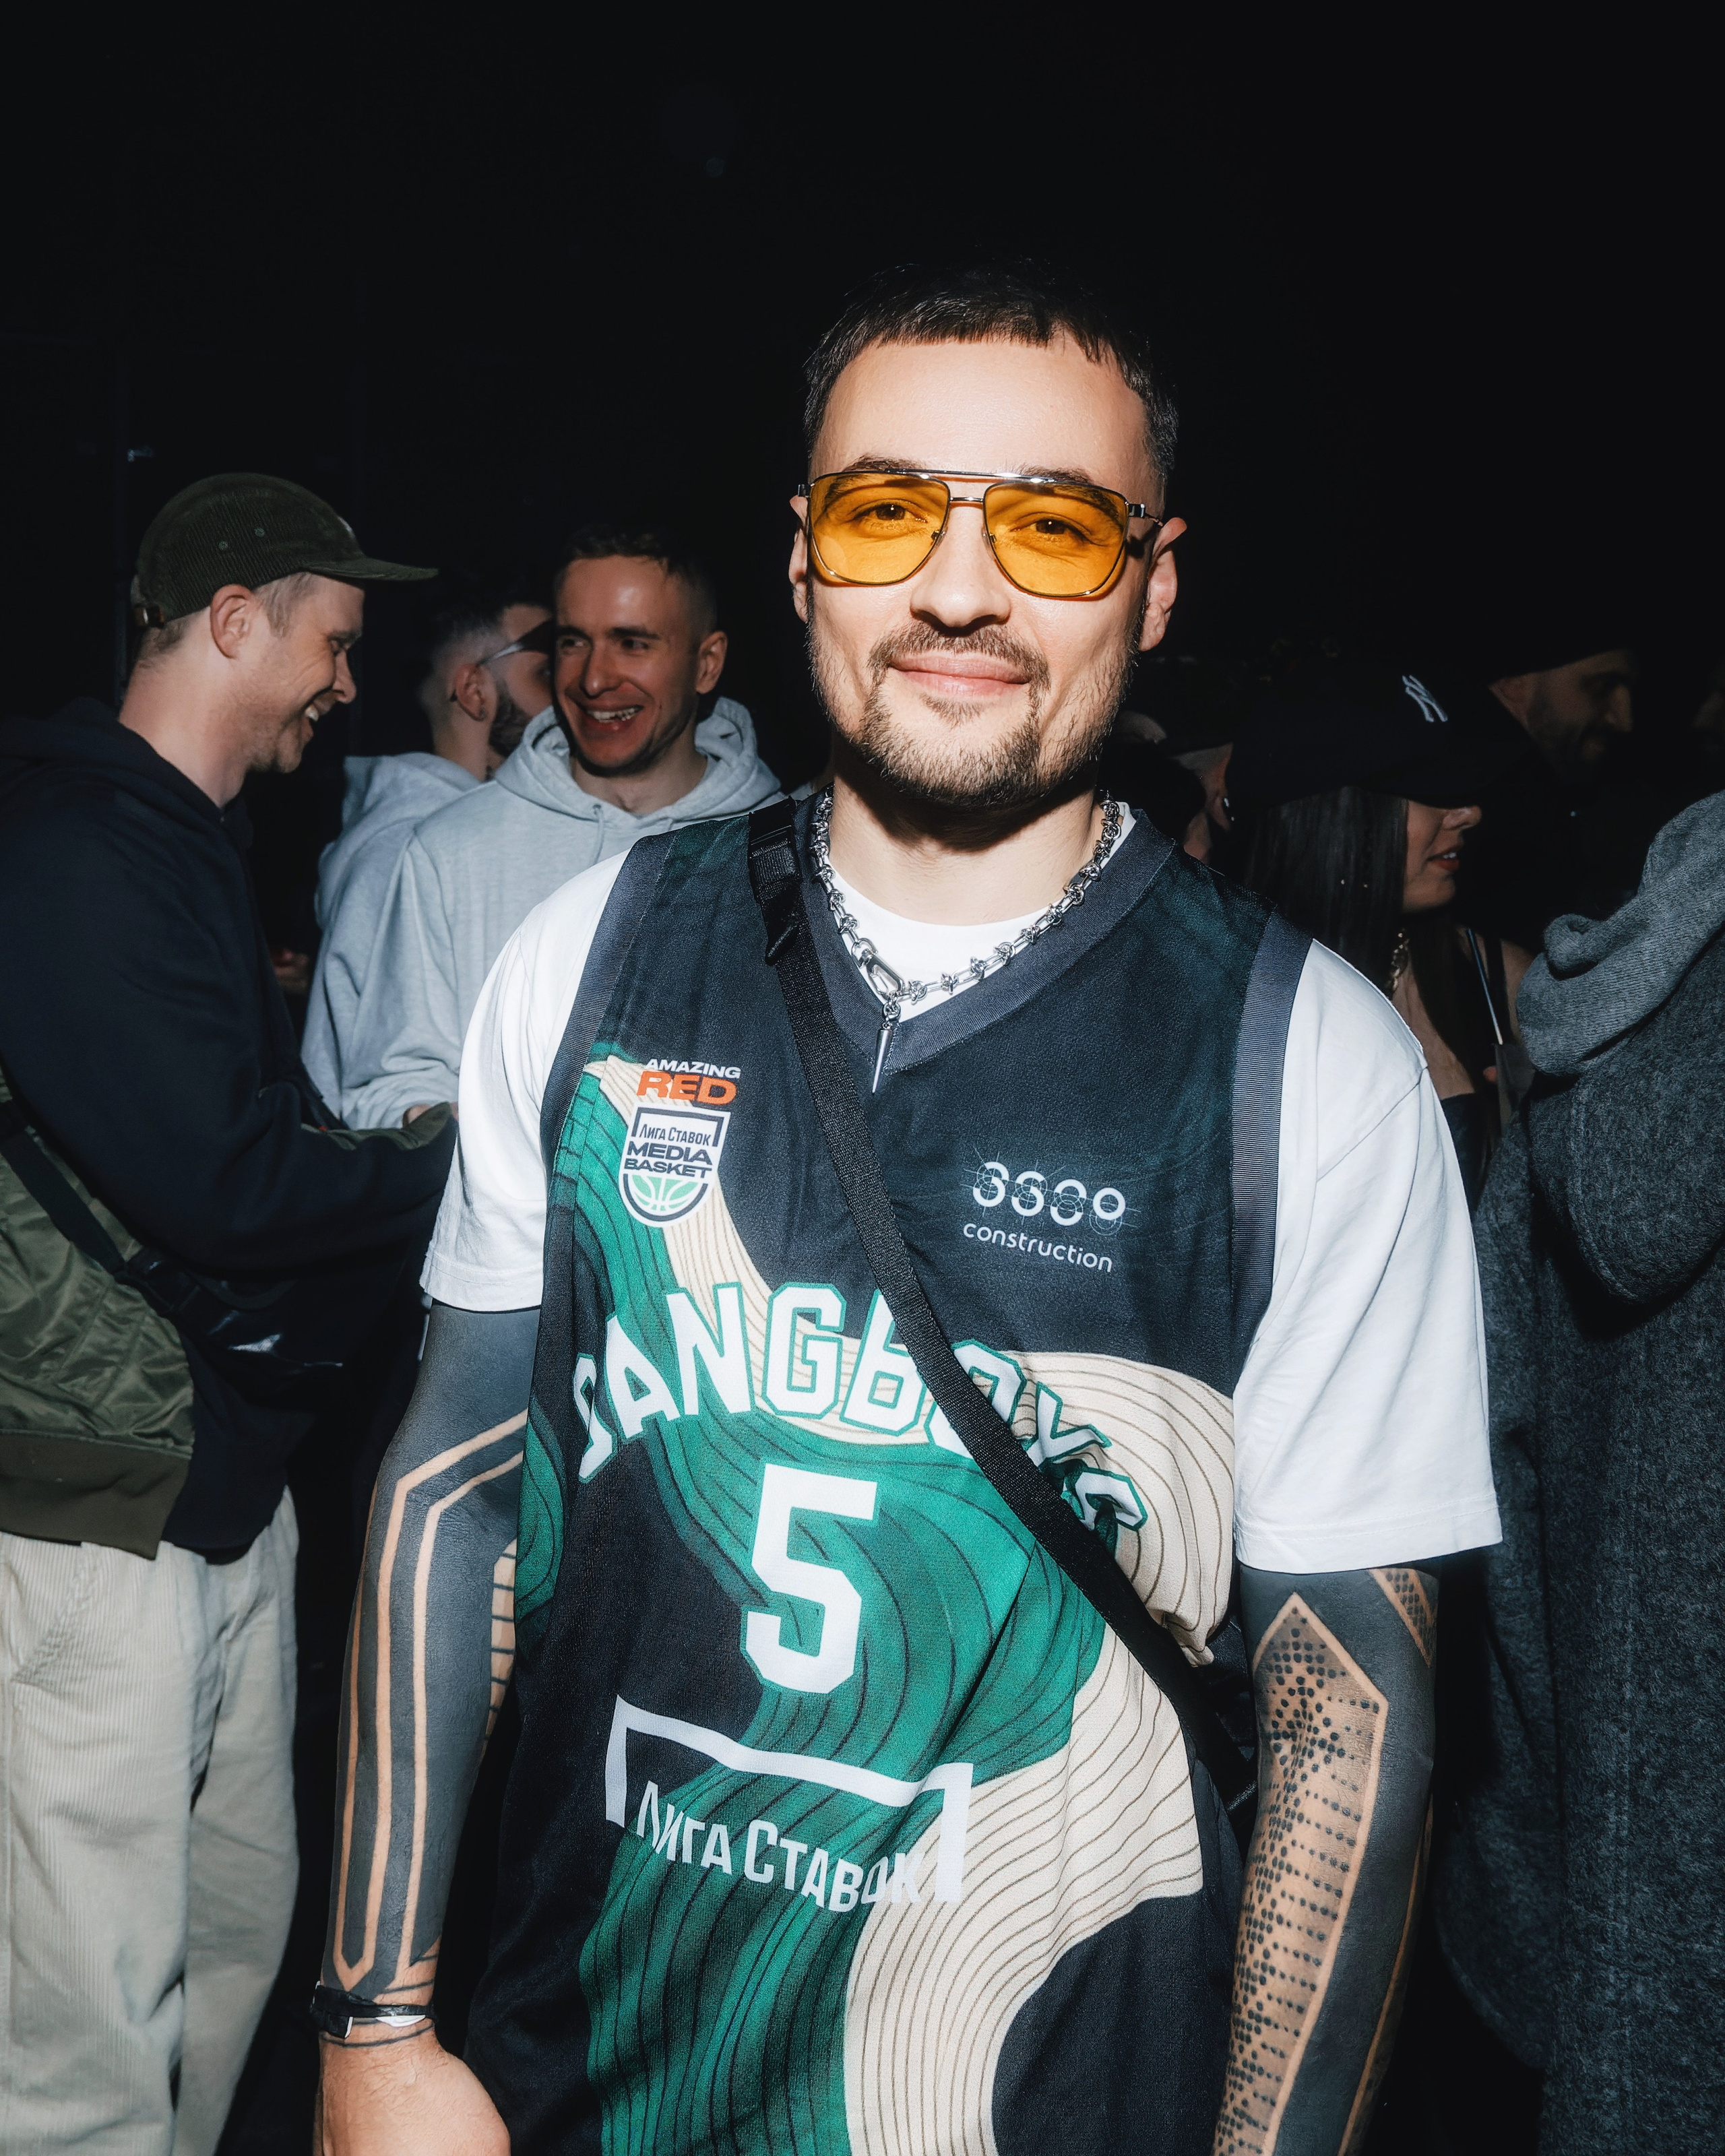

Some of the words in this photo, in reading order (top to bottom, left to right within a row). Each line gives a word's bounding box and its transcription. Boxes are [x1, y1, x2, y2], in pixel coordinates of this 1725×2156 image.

[644, 1058, 742, 1079] AMAZING
[636, 1070, 737, 1106] RED
[624, 1158, 712, 1178] BASKET
[627, 1141, 713, 1166] MEDIA
[963, 1223, 1112, 1273] construction
[745, 1462, 877, 1694] 5
